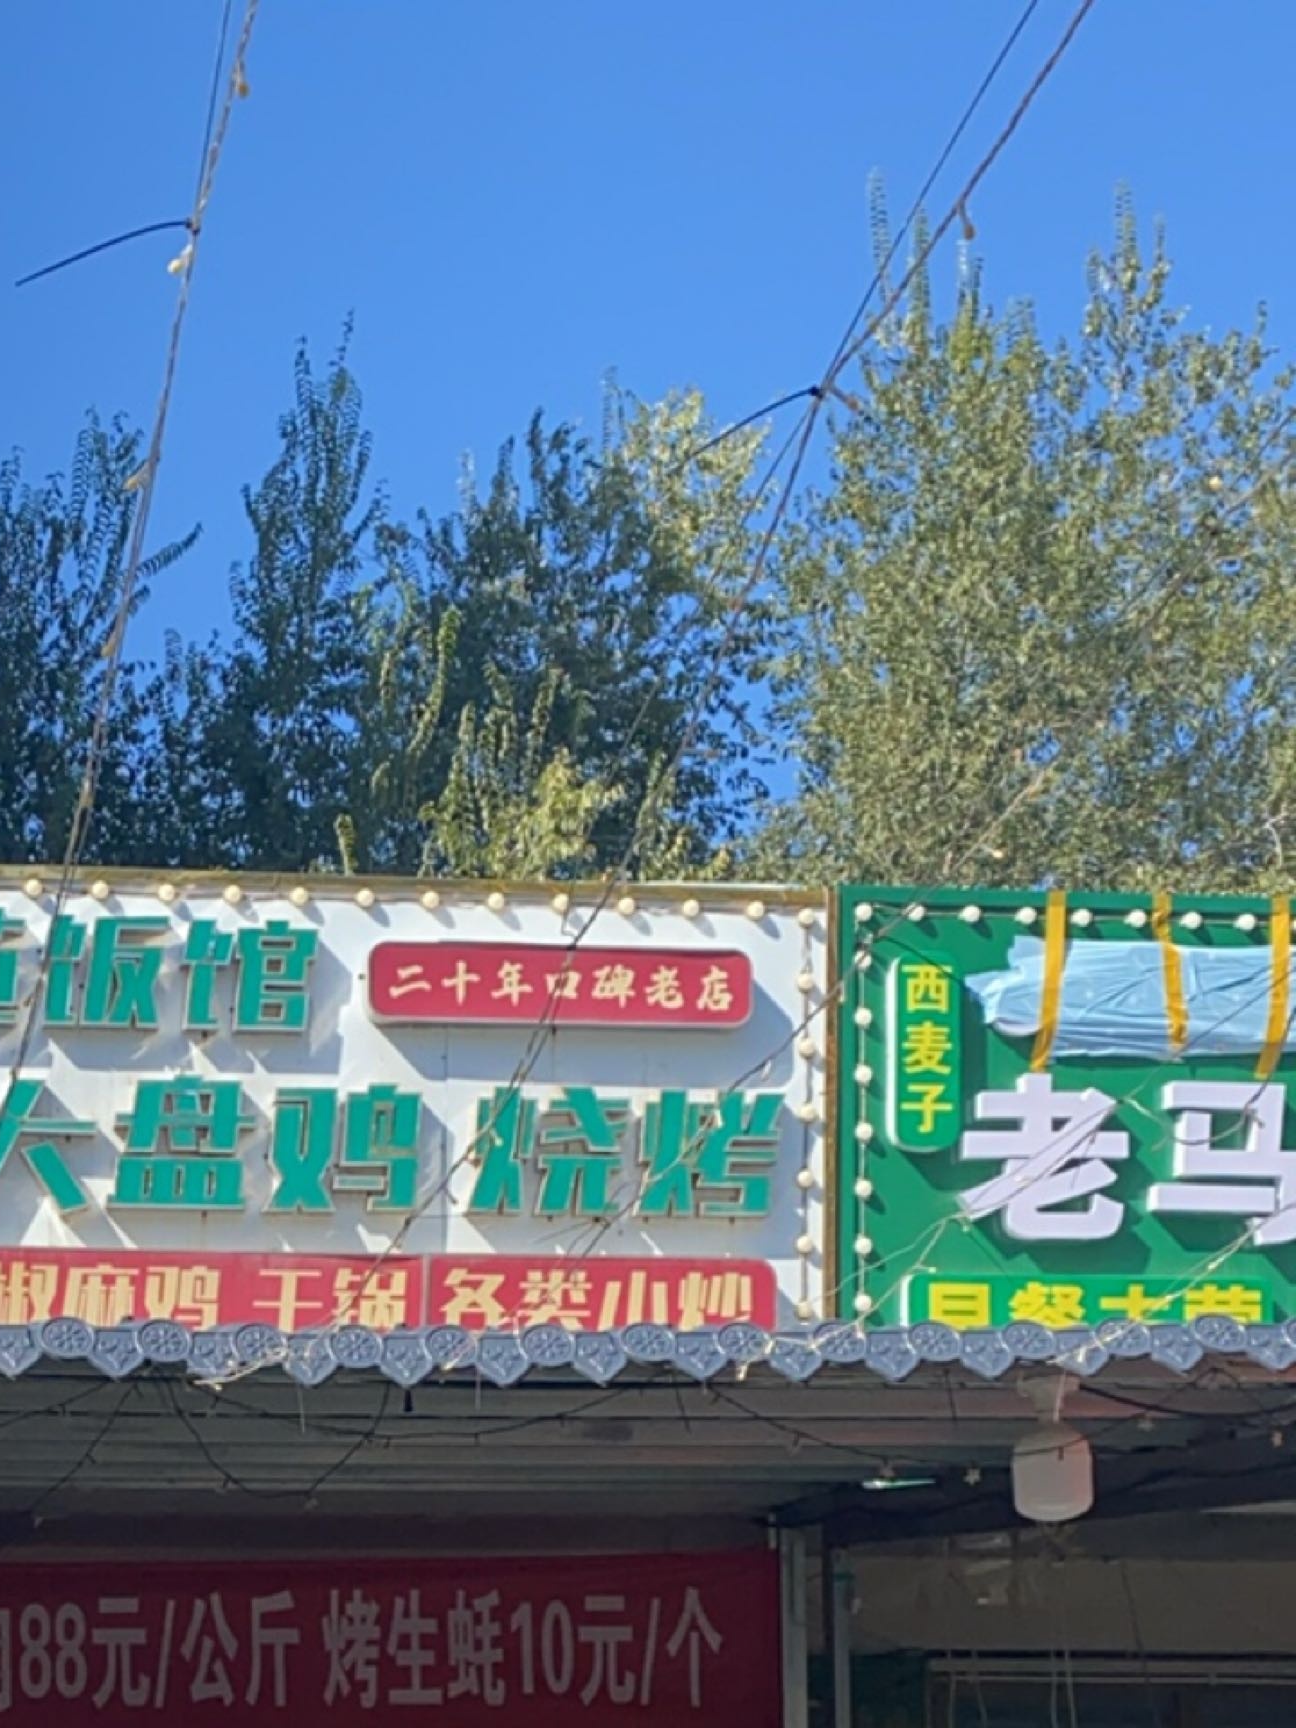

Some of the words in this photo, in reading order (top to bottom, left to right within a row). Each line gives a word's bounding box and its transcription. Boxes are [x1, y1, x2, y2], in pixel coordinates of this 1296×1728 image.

[388, 958, 735, 1012] 二十年口碑老店
[900, 964, 953, 1134] 西麦子
[467, 1086, 786, 1220] 烧烤
[957, 1073, 1296, 1246] 老马
[252, 1267, 408, 1331] 干锅
[439, 1267, 753, 1332] 各类小炒
[321, 1586, 723, 1709] 烤生蚝10元/个
